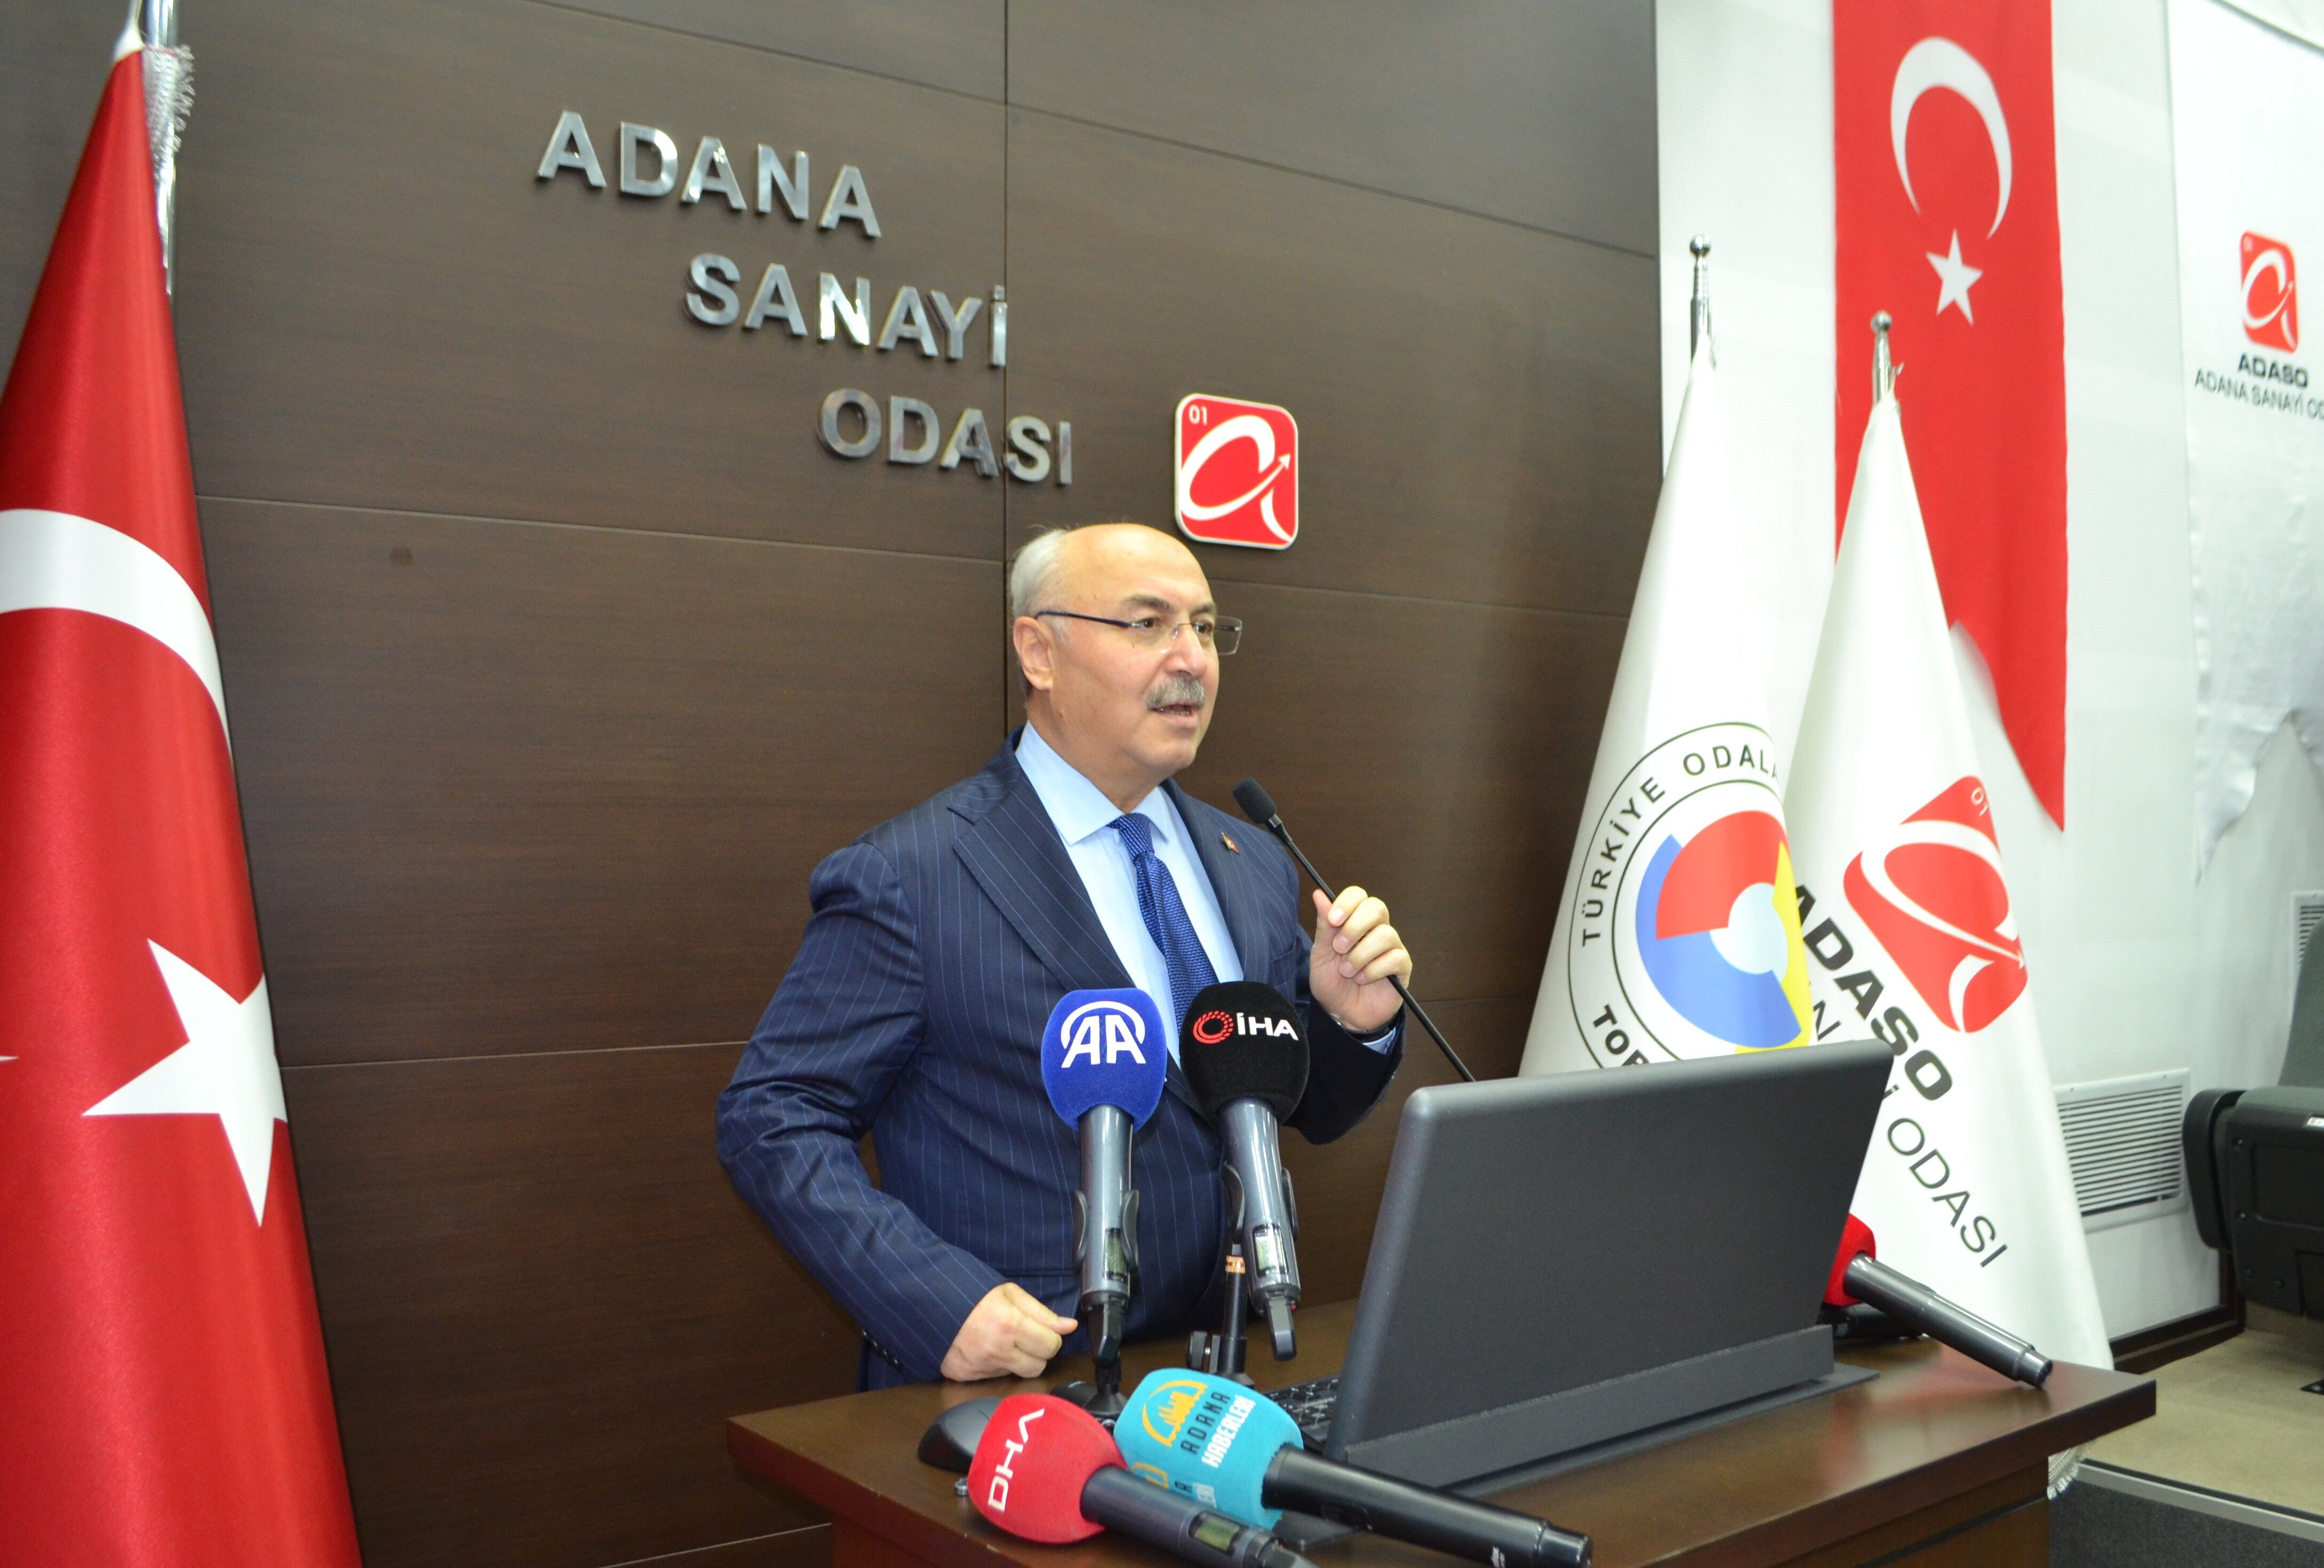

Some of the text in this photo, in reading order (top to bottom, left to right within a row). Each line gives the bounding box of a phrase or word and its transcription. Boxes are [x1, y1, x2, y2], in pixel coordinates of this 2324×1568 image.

[537, 110, 881, 238] ADANA
[686, 253, 1007, 367] SANAYİ
[1188, 405, 1208, 425] 01
[2194, 368, 2248, 403] ADANA
[2237, 353, 2308, 389] ADASO
[818, 387, 1071, 484] ODASI
[1582, 777, 1666, 946] TÜRKİYE
[1061, 1014, 1146, 1068] AA
[1237, 1012, 1299, 1041] İHA
[1796, 884, 1953, 1101] ADASO
[1887, 1117, 2008, 1268] ODASI
[988, 1408, 1045, 1512] DHA
[1180, 1392, 1231, 1455] ADANA
